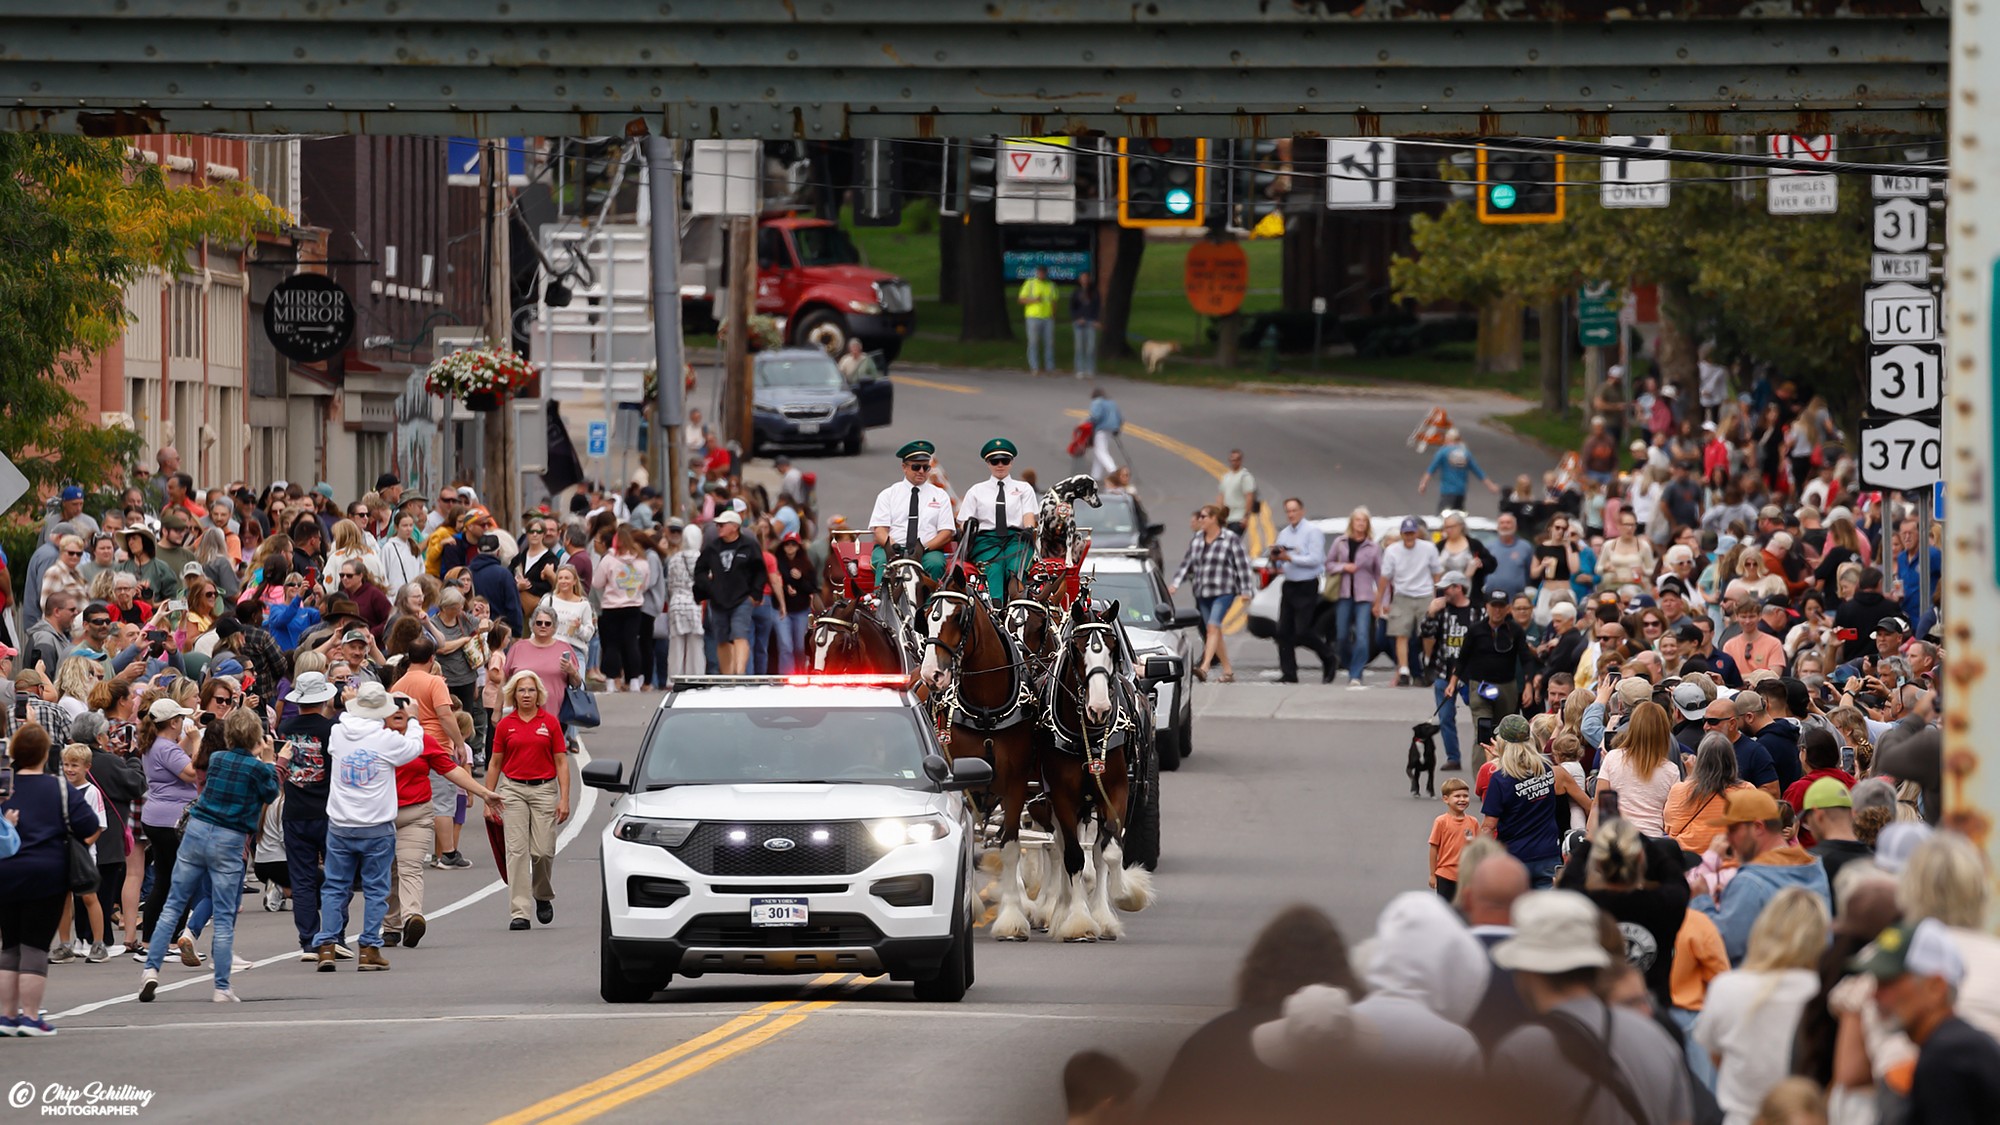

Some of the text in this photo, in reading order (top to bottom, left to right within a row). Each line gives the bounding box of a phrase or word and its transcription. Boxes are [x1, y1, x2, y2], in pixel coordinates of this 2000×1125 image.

[1780, 180, 1827, 194] VEHICLES
[1881, 177, 1920, 191] WEST
[1612, 186, 1658, 201] ONLY
[1773, 195, 1798, 208] OVER
[1882, 210, 1916, 239] 31
[1881, 259, 1921, 275] WEST
[273, 289, 345, 306] MIRROR
[273, 306, 345, 323] MIRROR
[1876, 304, 1931, 335] JCT
[1880, 361, 1925, 399] 31
[1868, 438, 1941, 470] 370
[1514, 770, 1554, 791] ENRICNG
[1515, 777, 1555, 798] VETERANS
[1527, 786, 1550, 801] LIVES
[768, 907, 790, 919] 301
